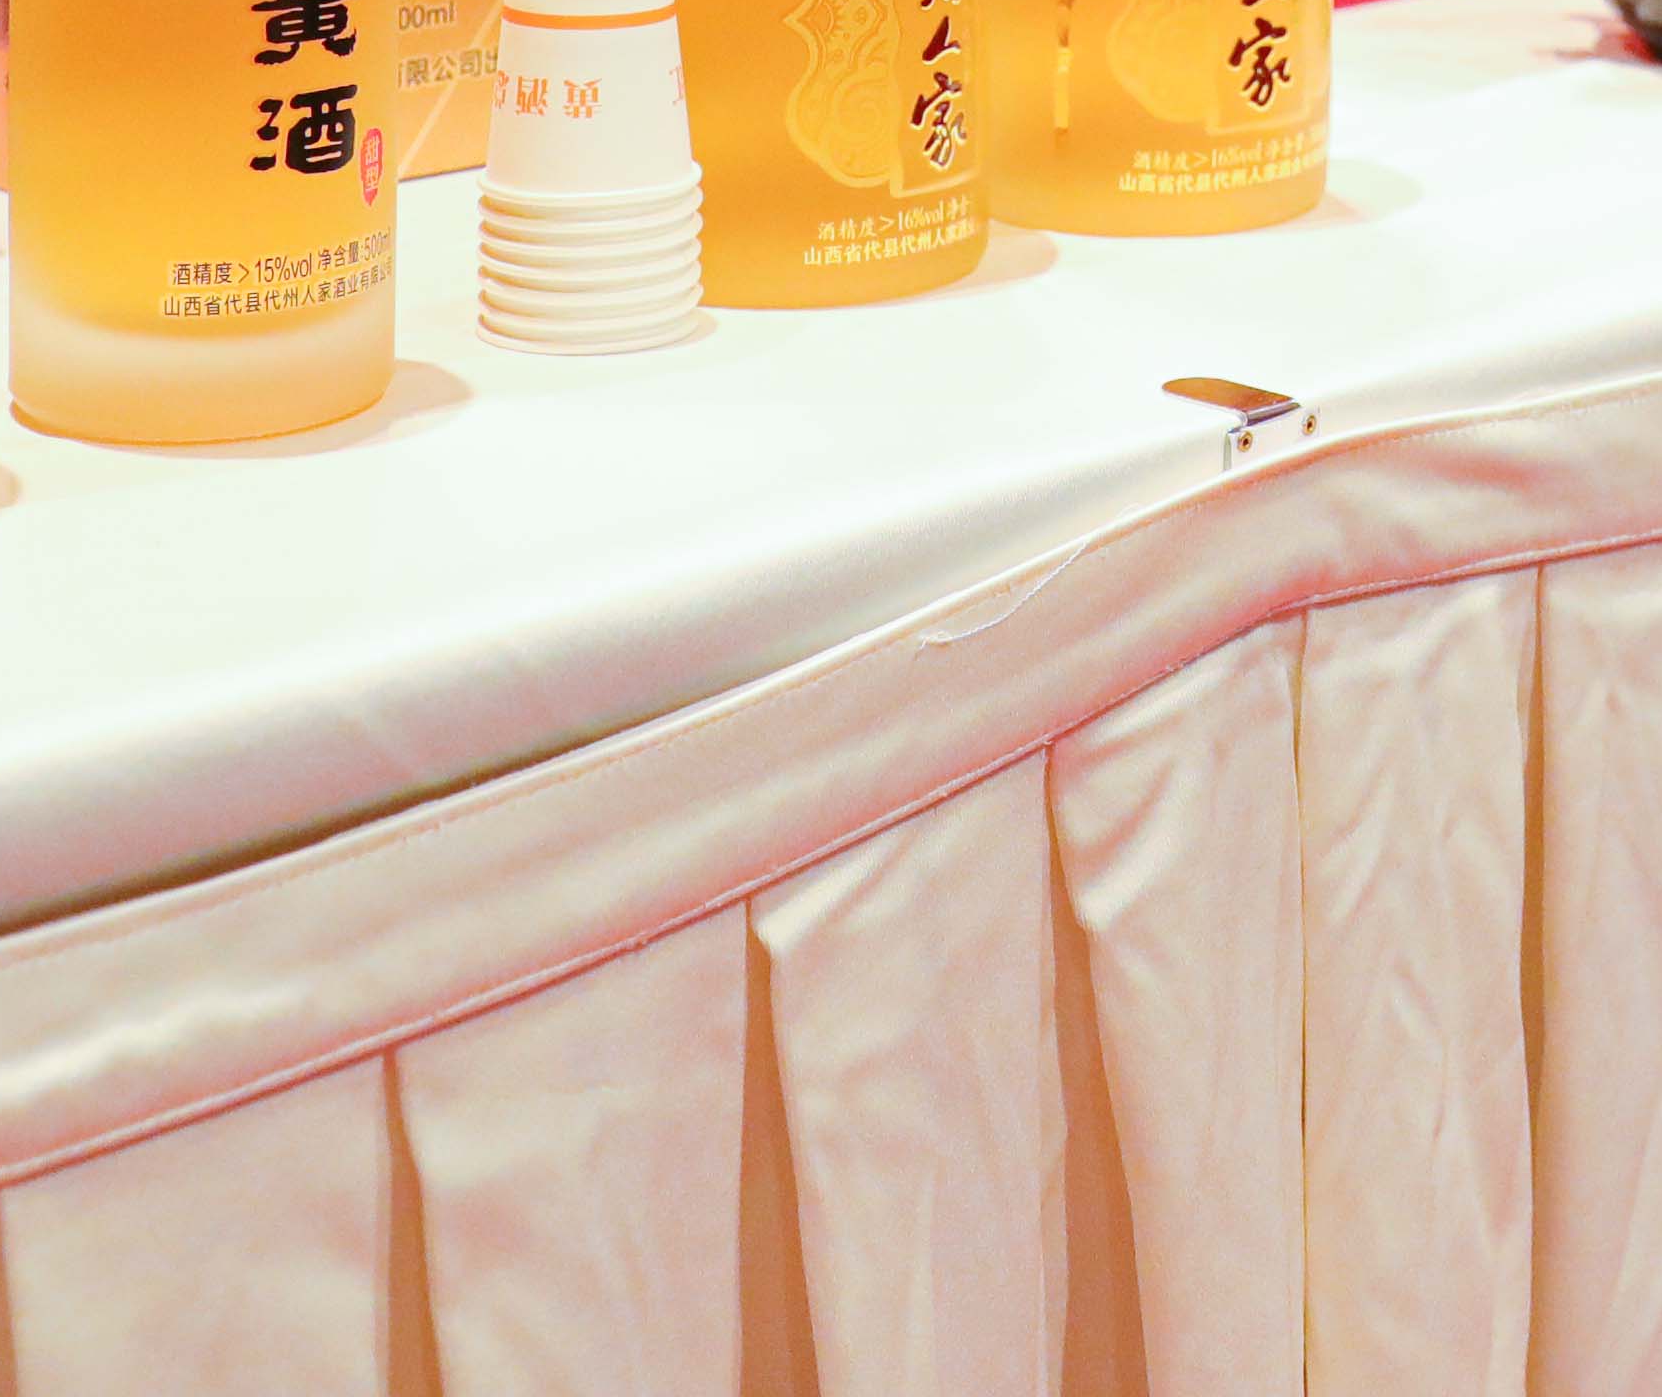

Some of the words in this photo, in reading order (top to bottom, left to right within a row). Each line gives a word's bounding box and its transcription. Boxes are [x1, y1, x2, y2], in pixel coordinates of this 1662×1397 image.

[163, 255, 394, 318] 山西省代县代州人家酒业有限公司
